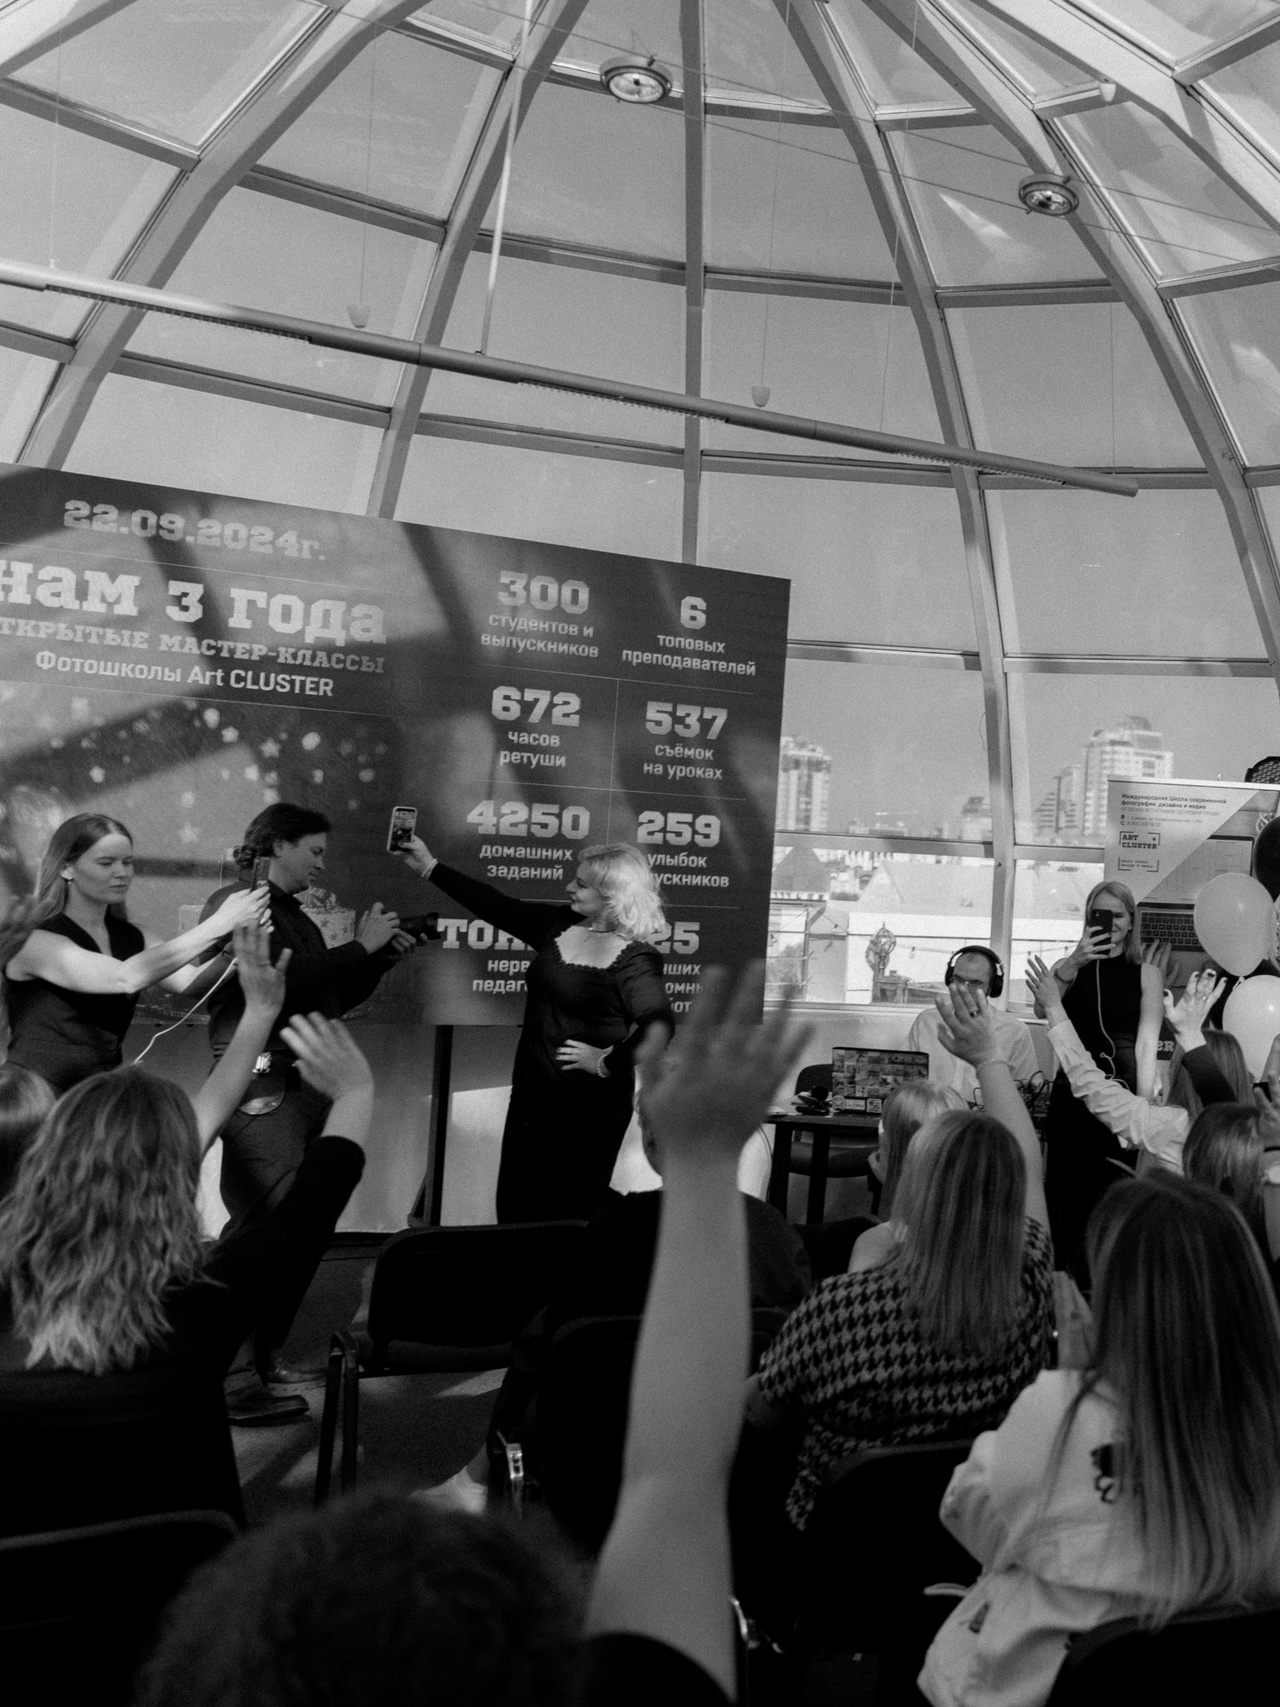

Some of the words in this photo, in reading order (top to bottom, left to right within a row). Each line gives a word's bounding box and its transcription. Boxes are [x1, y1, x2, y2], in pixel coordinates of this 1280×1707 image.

[64, 499, 325, 560] 22.09.2024г.
[0, 559, 141, 616] нам
[165, 580, 205, 623] 3
[228, 587, 387, 646] года
[497, 570, 590, 615] 300
[680, 595, 707, 630] 6
[488, 614, 578, 637] студентов
[583, 626, 594, 638] и
[158, 633, 386, 673] МАСТЕР-КЛАССЫ
[481, 632, 599, 658] выпускников
[657, 634, 726, 654] топовых
[35, 650, 182, 683] Фотошколы
[187, 665, 224, 687] Art
[229, 668, 334, 697] CLUSTER
[622, 649, 757, 676] преподавателей
[491, 685, 581, 727] 672
[645, 700, 729, 741] 537
[508, 730, 561, 747] часов
[500, 749, 567, 769] ретуши
[654, 742, 714, 761] съёмок
[643, 762, 663, 776] на
[667, 764, 723, 781] уроках
[466, 799, 591, 840] 4250
[637, 810, 721, 848] 259
[479, 844, 573, 861] домашних
[647, 851, 707, 868] улыбок
[487, 864, 564, 880] заданий
[653, 873, 730, 888] ускников
[487, 959, 531, 976] нерв
[662, 963, 701, 976] ших
[472, 979, 528, 995] педаг
